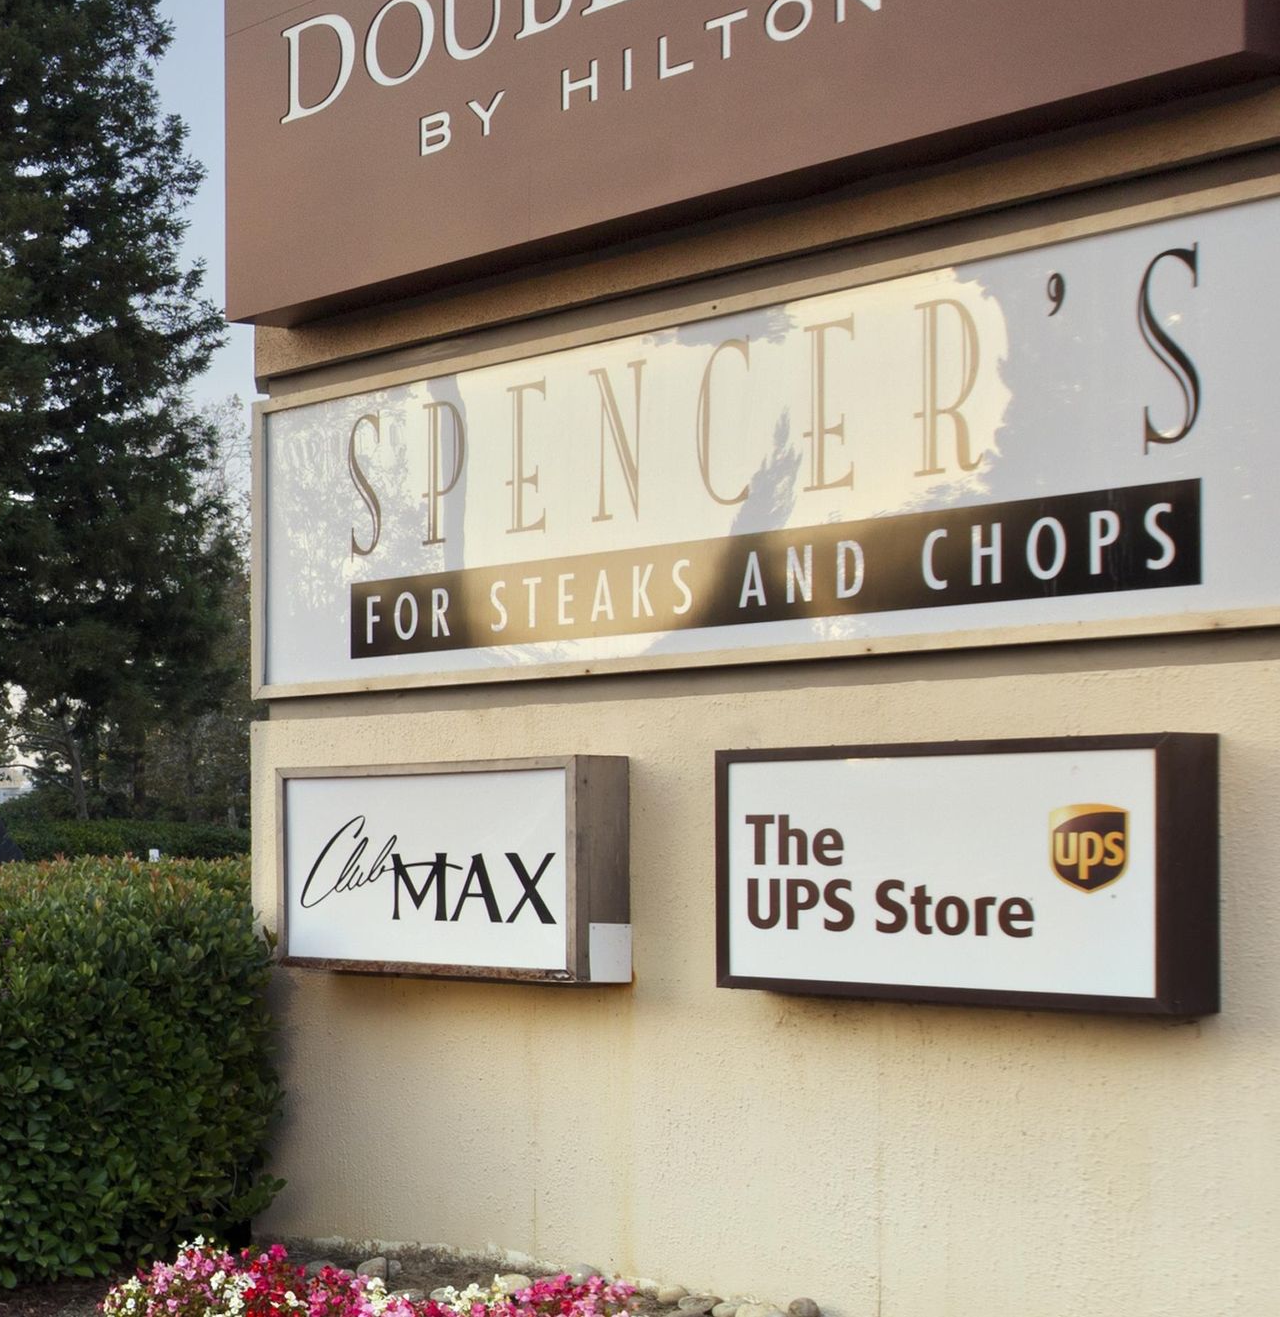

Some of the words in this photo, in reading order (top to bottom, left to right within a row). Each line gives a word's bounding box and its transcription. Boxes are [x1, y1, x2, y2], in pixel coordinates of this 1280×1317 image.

[419, 91, 506, 157] BY
[349, 241, 1202, 564] SPENCER'S
[365, 584, 451, 645] FOR
[489, 557, 694, 630] STEAKS
[738, 539, 865, 609] AND
[920, 502, 1177, 591] CHOPS
[745, 814, 844, 867] The
[1054, 830, 1125, 880] ups
[390, 852, 557, 924] MAX
[746, 878, 855, 933] UPS
[875, 879, 1035, 938] Store
